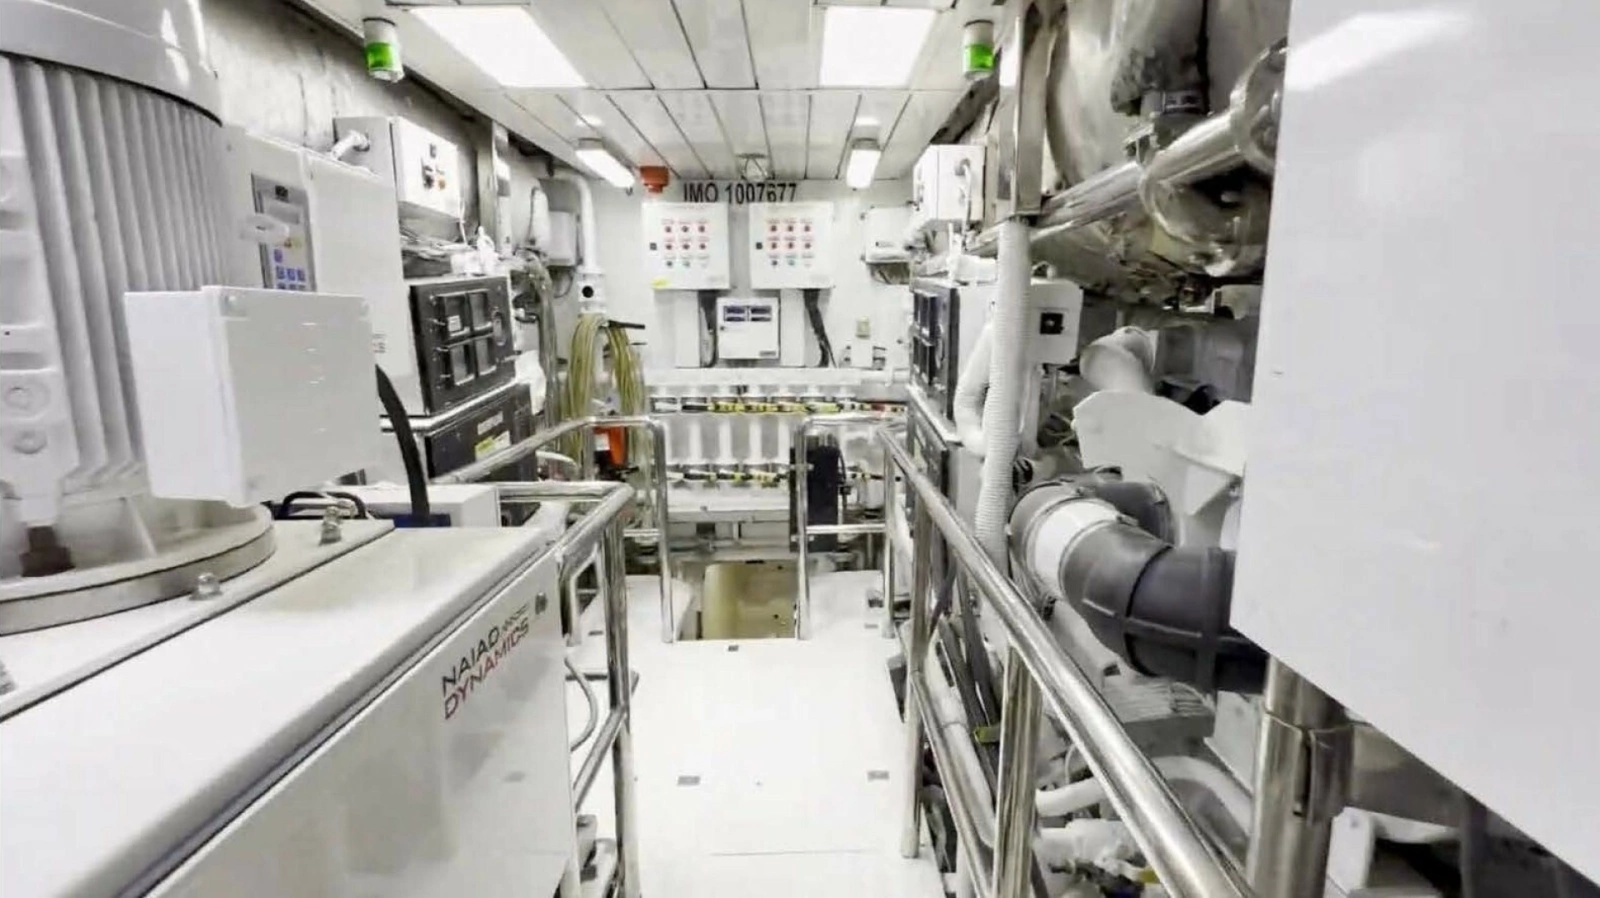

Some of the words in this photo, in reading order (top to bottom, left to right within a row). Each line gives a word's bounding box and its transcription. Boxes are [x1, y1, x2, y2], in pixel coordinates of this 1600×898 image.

[683, 182, 719, 204] IMO
[725, 182, 797, 204] 1007677
[442, 626, 499, 698] NAIAD
[444, 616, 529, 720] DYNAMICS
